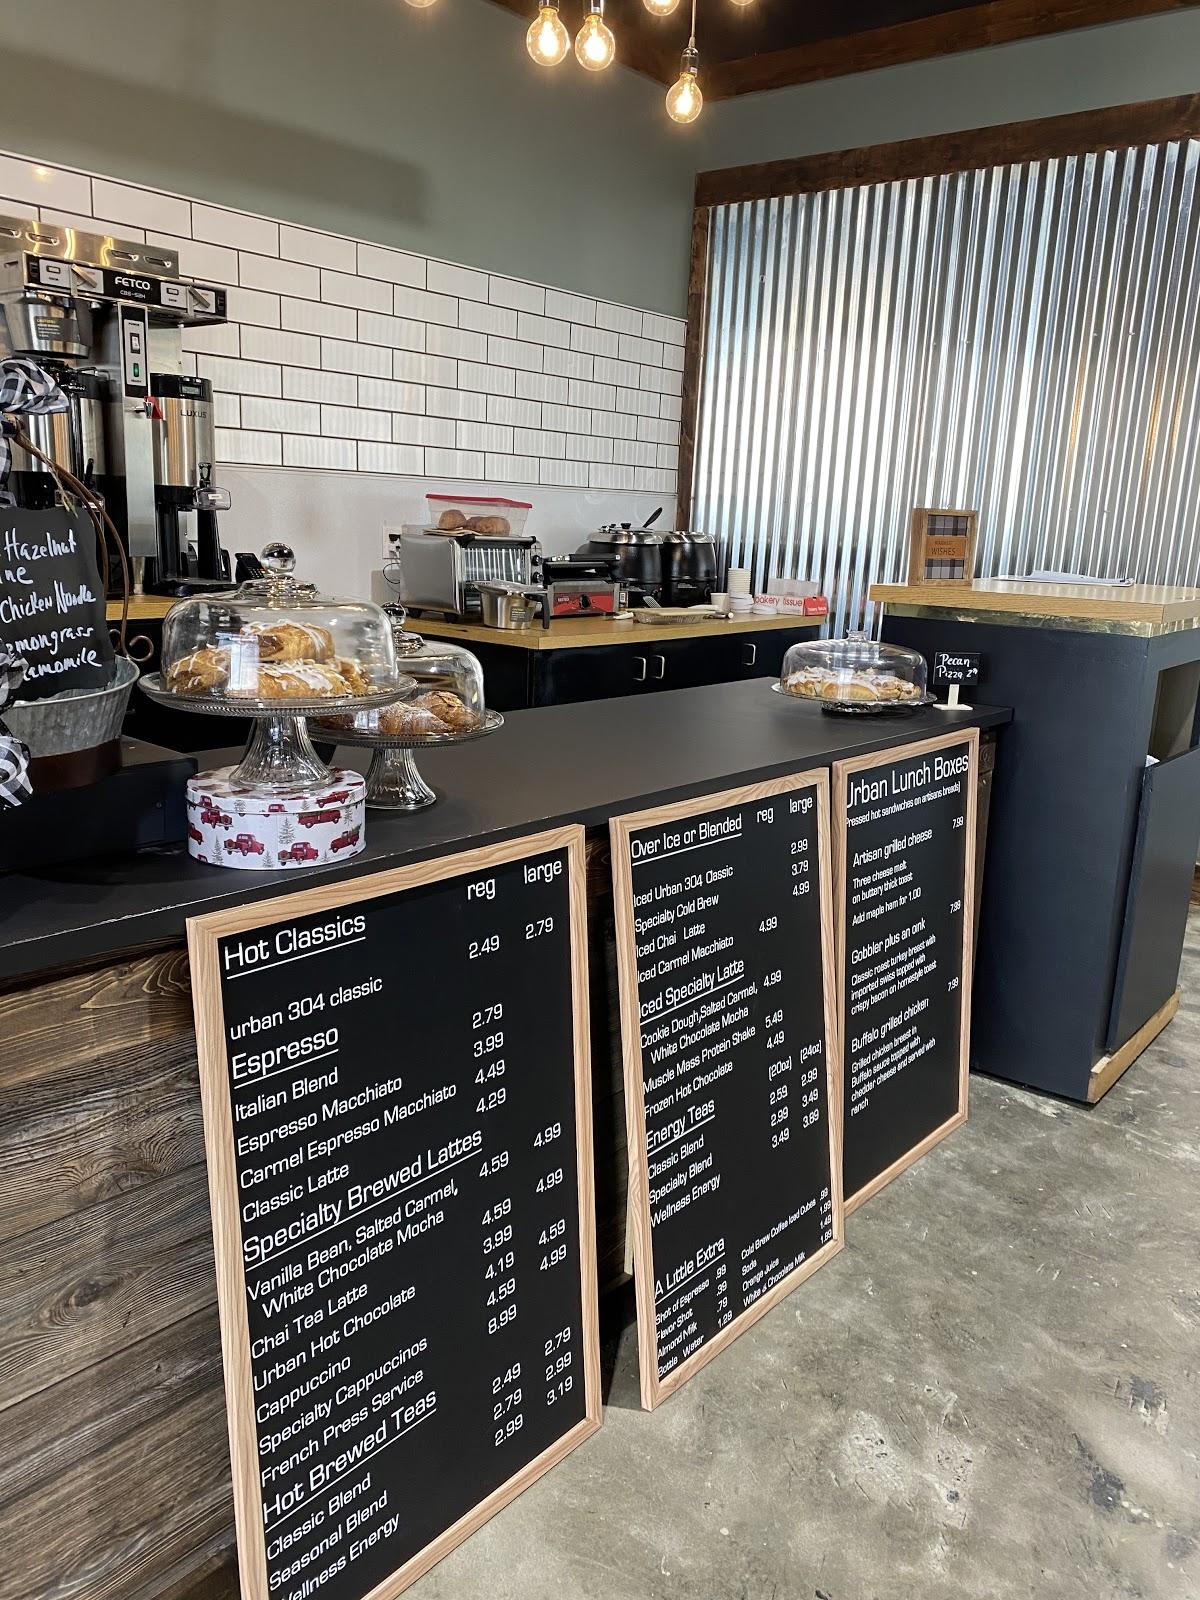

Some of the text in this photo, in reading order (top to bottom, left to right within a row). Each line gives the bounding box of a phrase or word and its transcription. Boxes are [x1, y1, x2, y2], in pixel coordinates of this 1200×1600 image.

[115, 277, 150, 290] FETCO
[180, 409, 207, 418] LUXUS
[0, 566, 33, 584] ne
[4, 528, 76, 561] Hazelnut
[0, 592, 52, 623] Chicken
[6, 626, 94, 659] emongrass
[936, 665, 963, 679] Pizza
[940, 654, 969, 667] Pecan
[631, 797, 813, 858] Over Ice or Blended reg large
[633, 839, 808, 907] Iced Urban 304 Classic 2.99
[635, 860, 808, 936] Specialty Cold Brew 3.79
[224, 860, 562, 970] Hot Classics reg large
[637, 881, 809, 958] Iced Chai Latte 4.99
[230, 917, 553, 1041] urban 304 classic 2.49 2.79
[638, 916, 777, 983] Iced Carmel Macchiato 4.99
[639, 960, 744, 1018] Iced Specialty Latte
[640, 1025, 669, 1048] Cookie
[727, 982, 758, 1003] Carmel,
[763, 970, 782, 987] 4.99
[232, 1027, 339, 1080] Espresso
[642, 1009, 783, 1095] Muscle Mass Protein Shake 5.49
[651, 1006, 749, 1064] White Chocolate Mocha
[235, 1067, 339, 1121] Italian Blend
[644, 1031, 785, 1120] Frozen Hot Chocolate 4.49
[237, 1077, 402, 1156] Espresso Macchiato
[240, 1084, 457, 1189] Carmel Espresso Macchiato
[646, 1099, 715, 1150] Energy Teas
[648, 1134, 704, 1179] Classic Blend
[649, 1153, 712, 1204] Specialty Blend
[243, 1164, 349, 1223] Classic Latte
[244, 1130, 482, 1262] Specialty Brewed Lattes
[651, 1174, 721, 1228] Wellness Energy
[247, 1179, 458, 1300] Vanilla Bean, Salted Carmel,
[262, 1210, 444, 1318] White Chocolate Mocha
[655, 1238, 725, 1299] A Little Extra
[251, 1283, 368, 1359] Chai Tea Latte
[254, 1285, 416, 1391] Urban Hot Chocolate
[257, 1356, 351, 1424] Cappuccino
[259, 1338, 428, 1455] Specialty Cappuccinos
[262, 1370, 424, 1487] French Press Service
[263, 1391, 436, 1524] Hot Brewed Teas
[268, 1473, 371, 1560] Classic Blend
